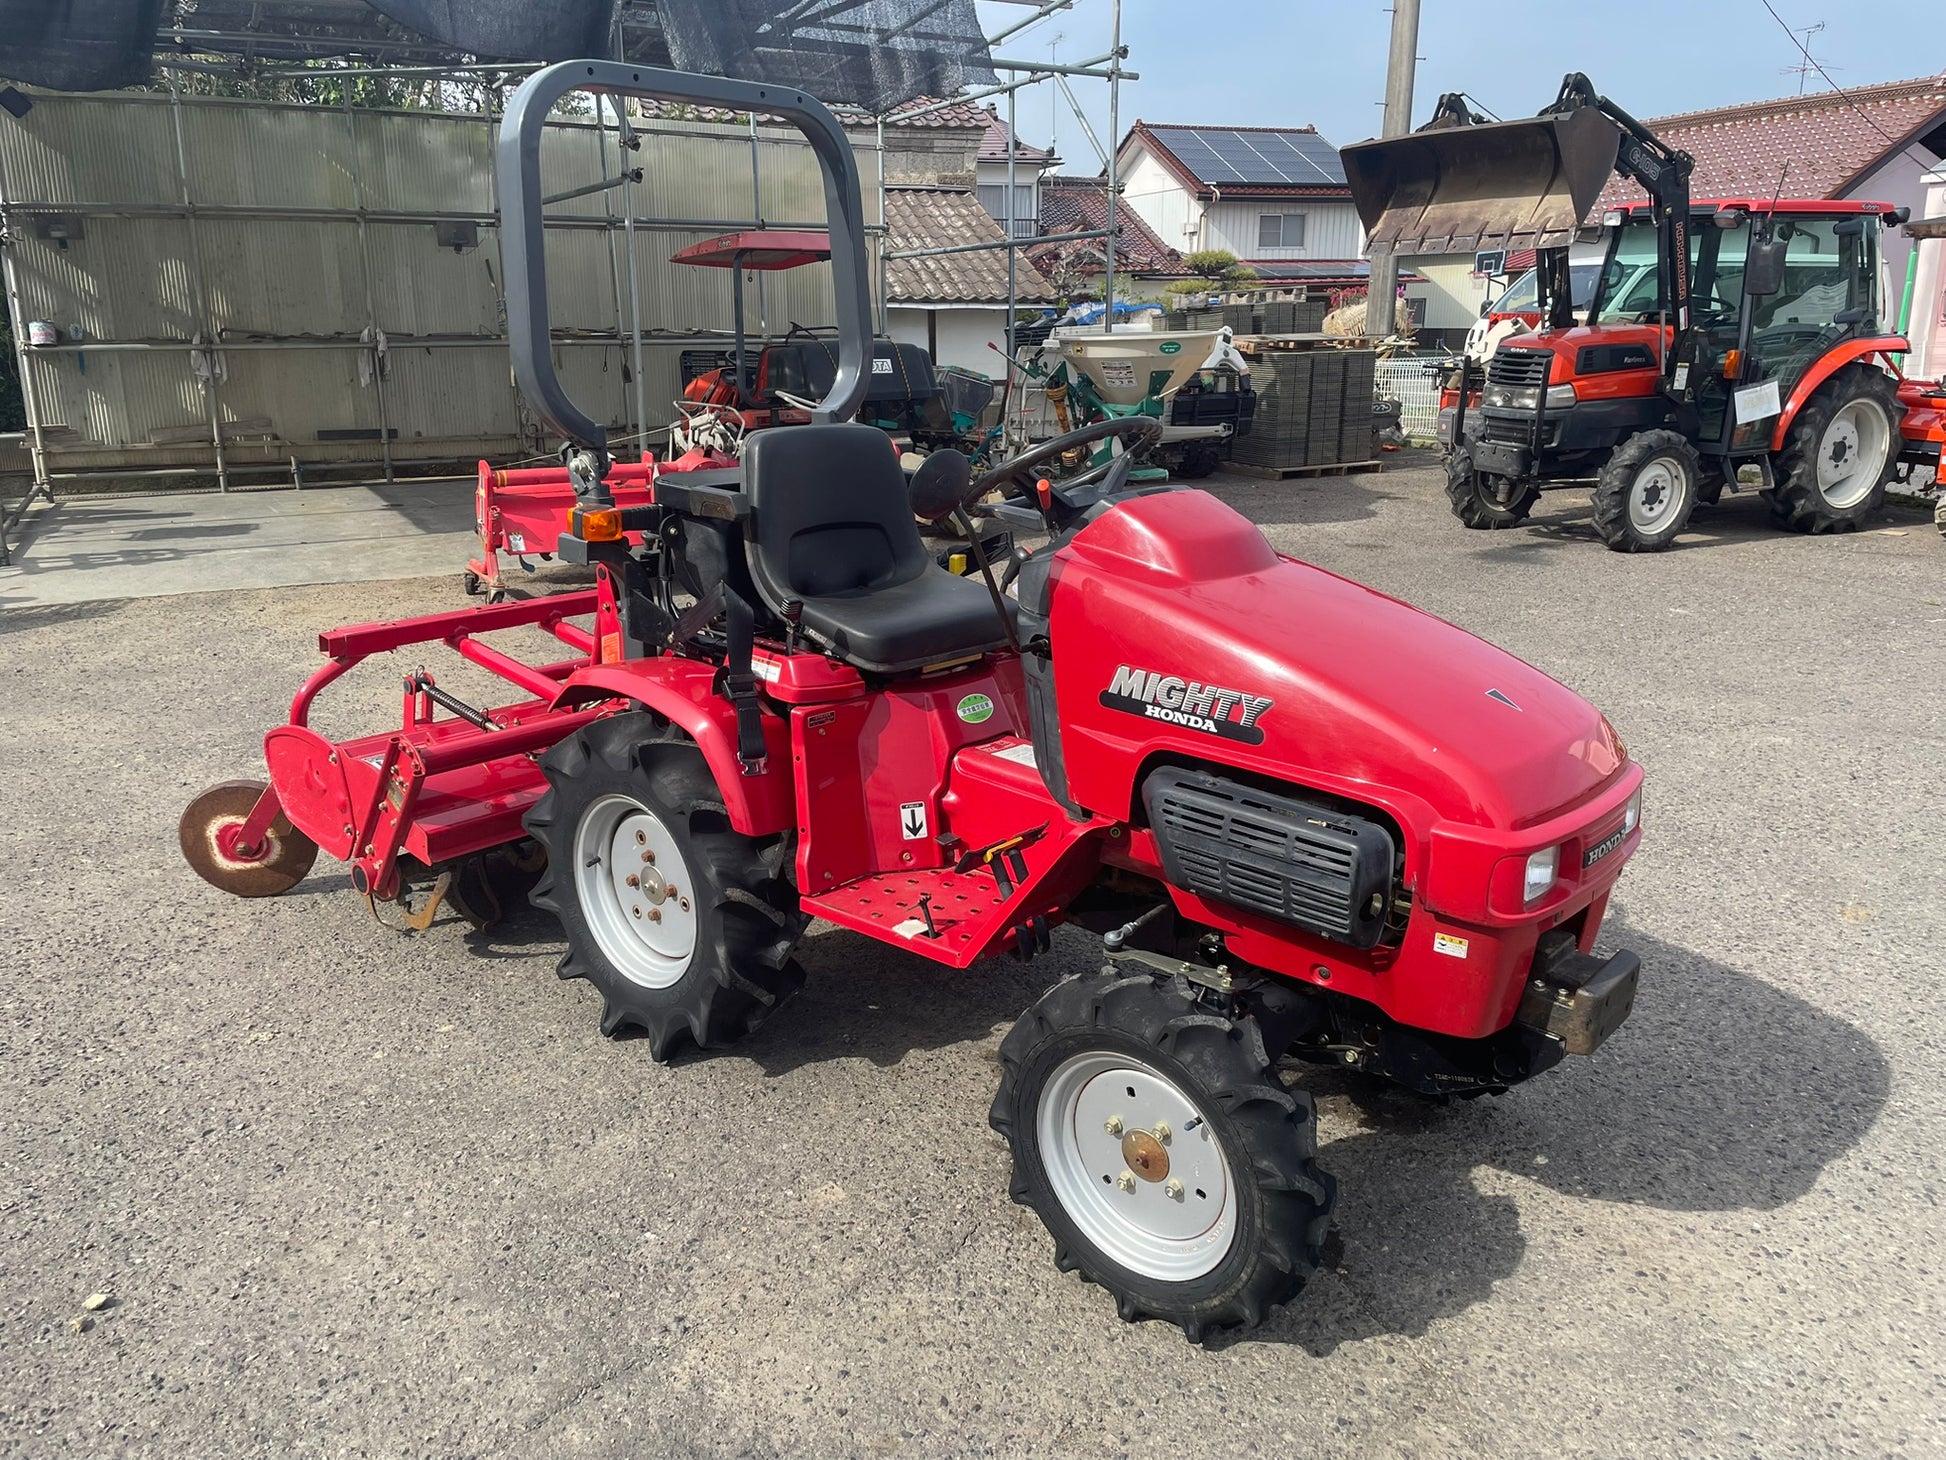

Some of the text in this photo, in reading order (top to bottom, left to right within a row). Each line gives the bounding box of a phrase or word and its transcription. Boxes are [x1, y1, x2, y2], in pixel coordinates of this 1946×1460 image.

[1675, 221, 1687, 301] HAYABUSA
[1107, 665, 1274, 728] MIGHTY
[1145, 704, 1218, 733] HONDA
